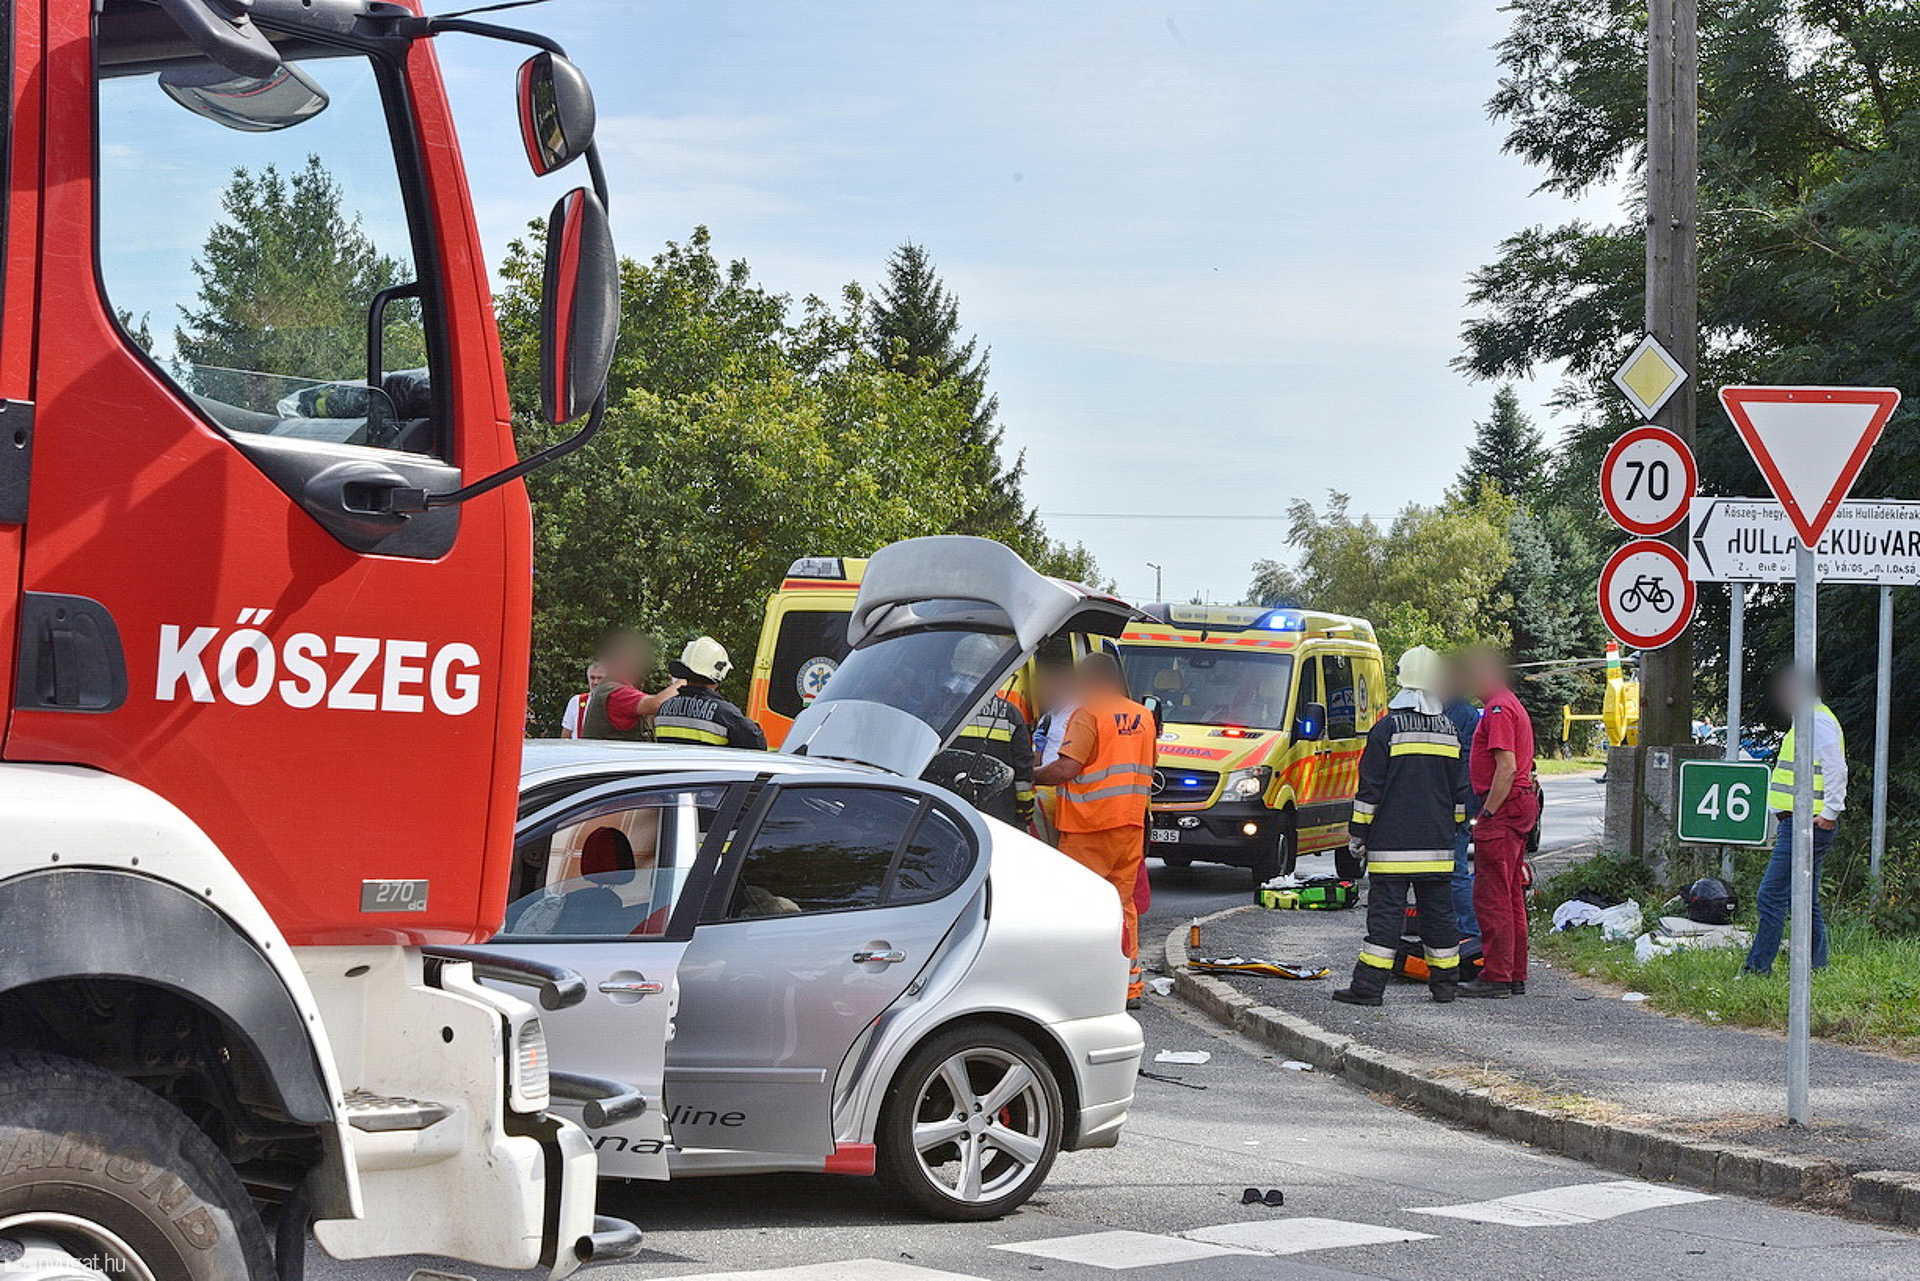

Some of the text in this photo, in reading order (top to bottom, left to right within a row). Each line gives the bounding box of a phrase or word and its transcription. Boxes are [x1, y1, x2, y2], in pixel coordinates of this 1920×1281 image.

[1626, 461, 1668, 500] 70
[155, 607, 481, 716] KŐSZEG
[1697, 783, 1751, 821] 46
[376, 883, 414, 901] 270
[671, 1105, 746, 1126] line
